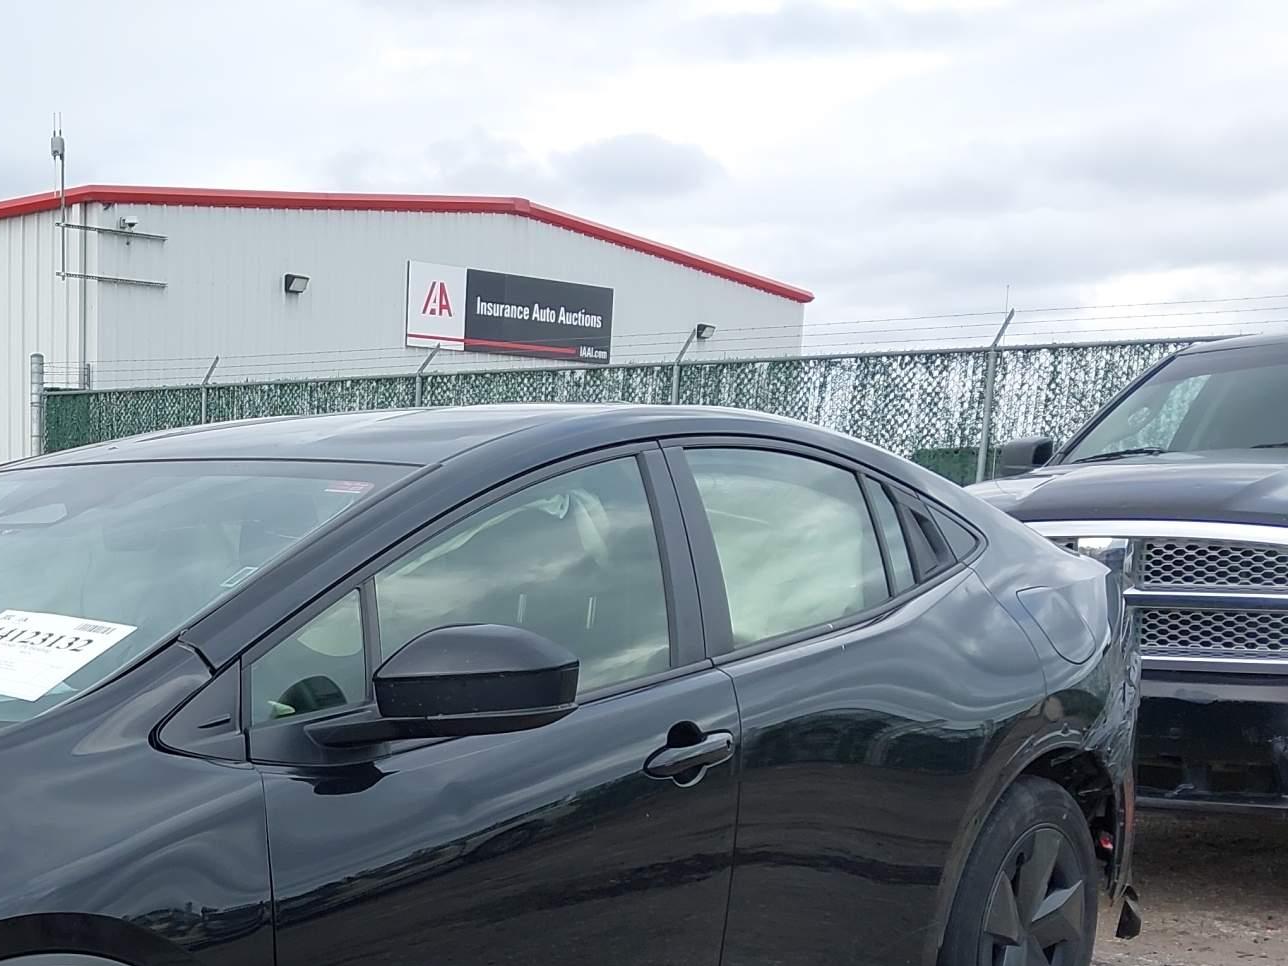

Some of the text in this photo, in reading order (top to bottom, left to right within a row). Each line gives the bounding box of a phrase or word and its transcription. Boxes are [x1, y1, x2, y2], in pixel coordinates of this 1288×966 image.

[476, 296, 602, 329] Insurance Auto Auctions
